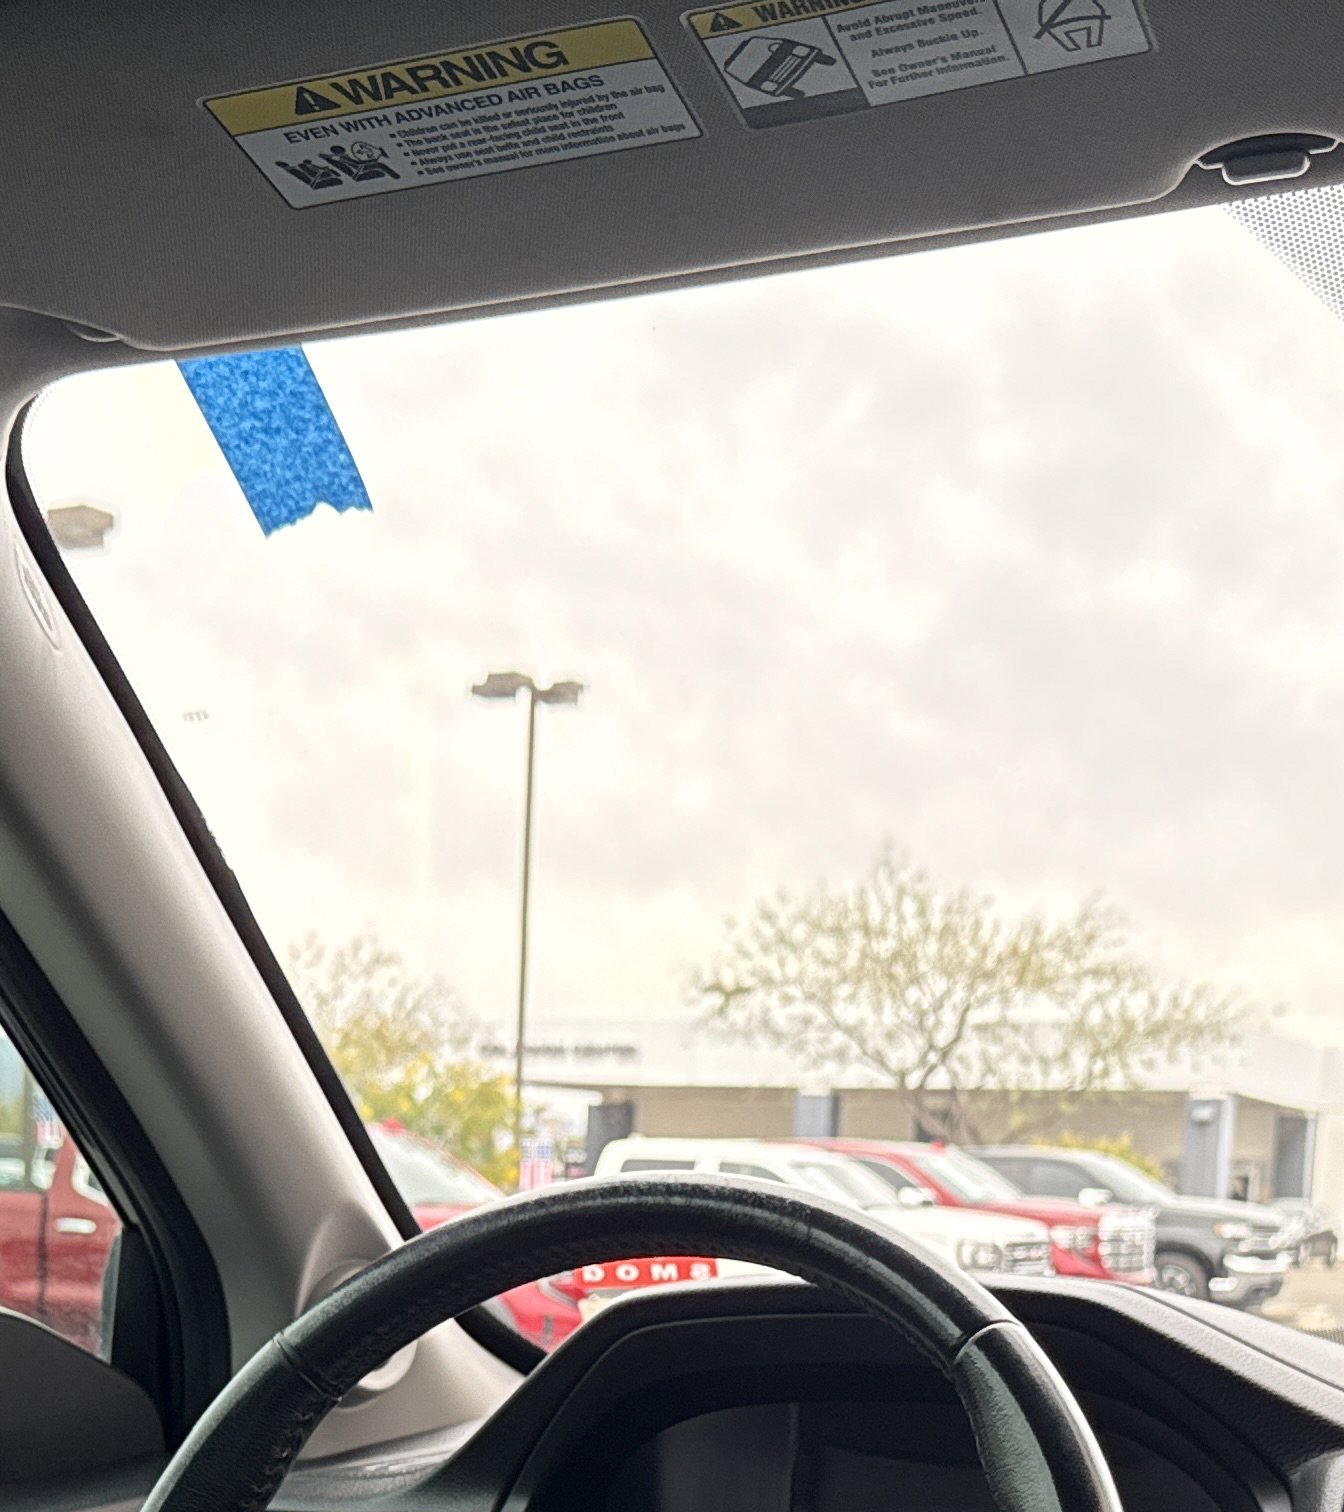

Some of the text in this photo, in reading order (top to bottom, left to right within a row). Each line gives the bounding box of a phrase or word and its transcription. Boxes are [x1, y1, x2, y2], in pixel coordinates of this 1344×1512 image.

[752, 0, 868, 22] WARNI
[837, 18, 871, 33] Avoid
[849, 30, 872, 41] and
[872, 43, 914, 58] Always
[330, 41, 569, 105] WARNING
[284, 74, 604, 144] EVEN WITH ADVANCED AIR BAGS
